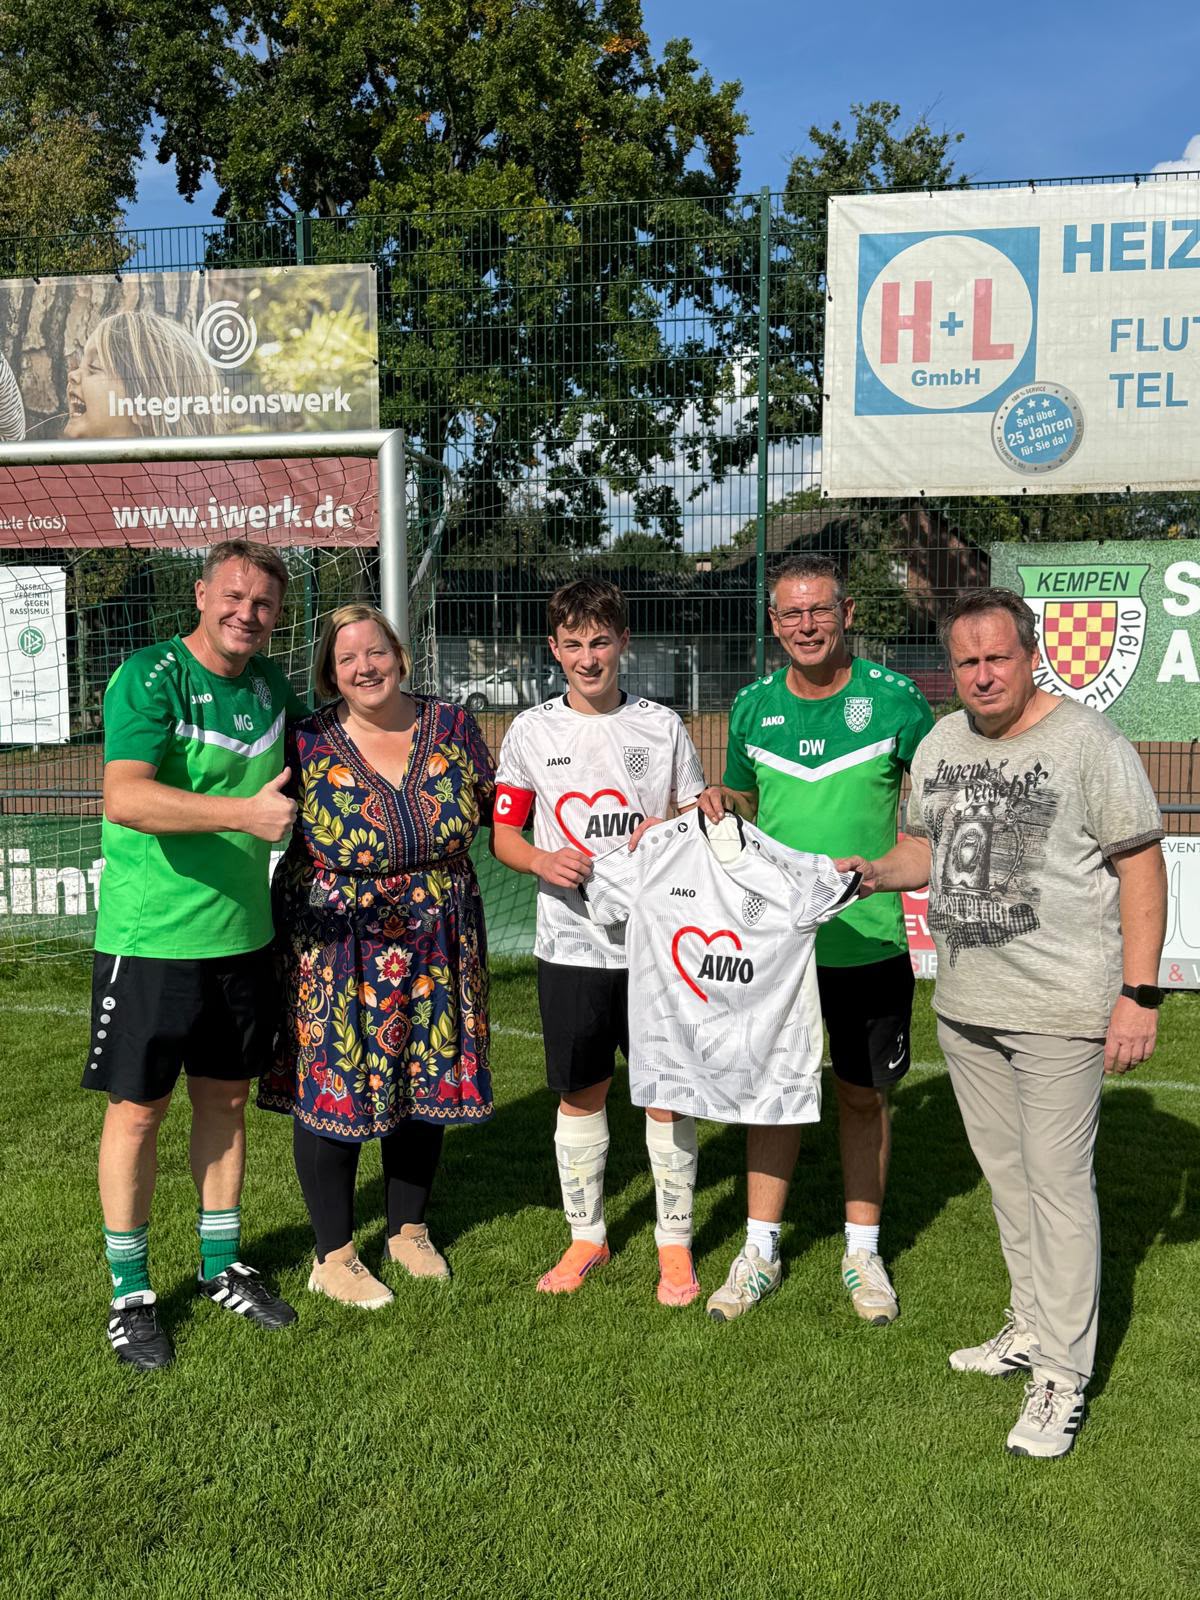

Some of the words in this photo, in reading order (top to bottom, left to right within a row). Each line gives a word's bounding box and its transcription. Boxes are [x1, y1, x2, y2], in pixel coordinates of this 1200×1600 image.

[1063, 220, 1200, 273] HEIZ
[911, 368, 981, 387] GmbH
[1109, 372, 1189, 409] TEL
[108, 388, 352, 423] Integrationswerk
[1016, 416, 1035, 428] Seit
[1036, 409, 1057, 421] über
[1007, 431, 1025, 447] 25
[1028, 417, 1073, 441] Jahren
[1021, 446, 1034, 457] für
[1035, 440, 1051, 452] Sie
[1052, 434, 1068, 446] da!
[0, 515, 24, 530] ule
[112, 495, 355, 530] www.iwerk.de
[1036, 571, 1130, 593] KEMPEN
[1117, 610, 1142, 657] 1910
[232, 713, 254, 732] MG
[761, 715, 785, 727] JAKO
[799, 739, 826, 756] DW
[546, 756, 571, 767] JAKO
[496, 793, 512, 815] C
[585, 812, 645, 839] AWO
[669, 887, 697, 898] JAKO
[697, 954, 754, 984] AWO
[1168, 963, 1184, 982] &
